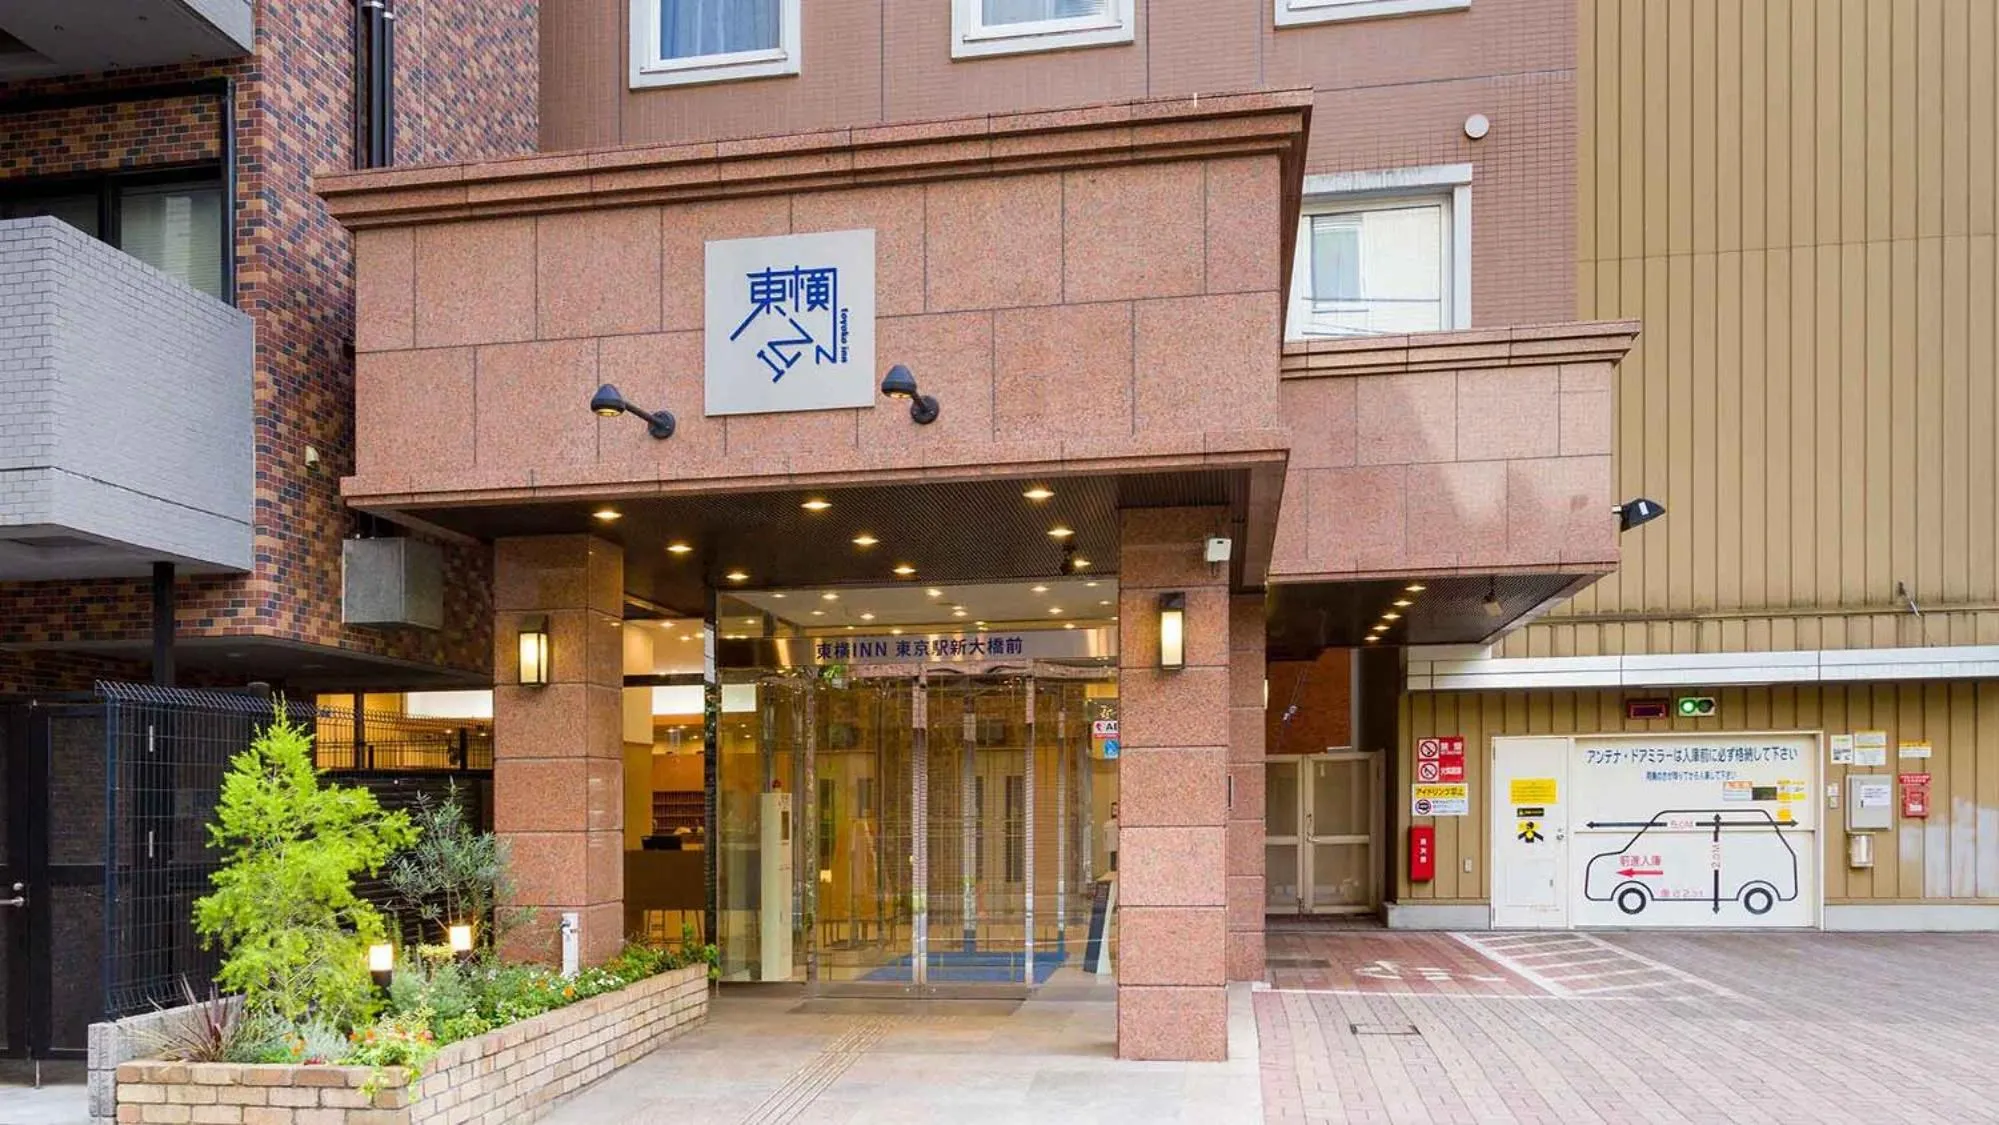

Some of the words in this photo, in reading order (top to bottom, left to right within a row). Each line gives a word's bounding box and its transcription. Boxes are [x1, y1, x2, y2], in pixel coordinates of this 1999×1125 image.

[816, 641, 887, 659] 東横INN
[895, 637, 1022, 657] 東京駅新大橋前
